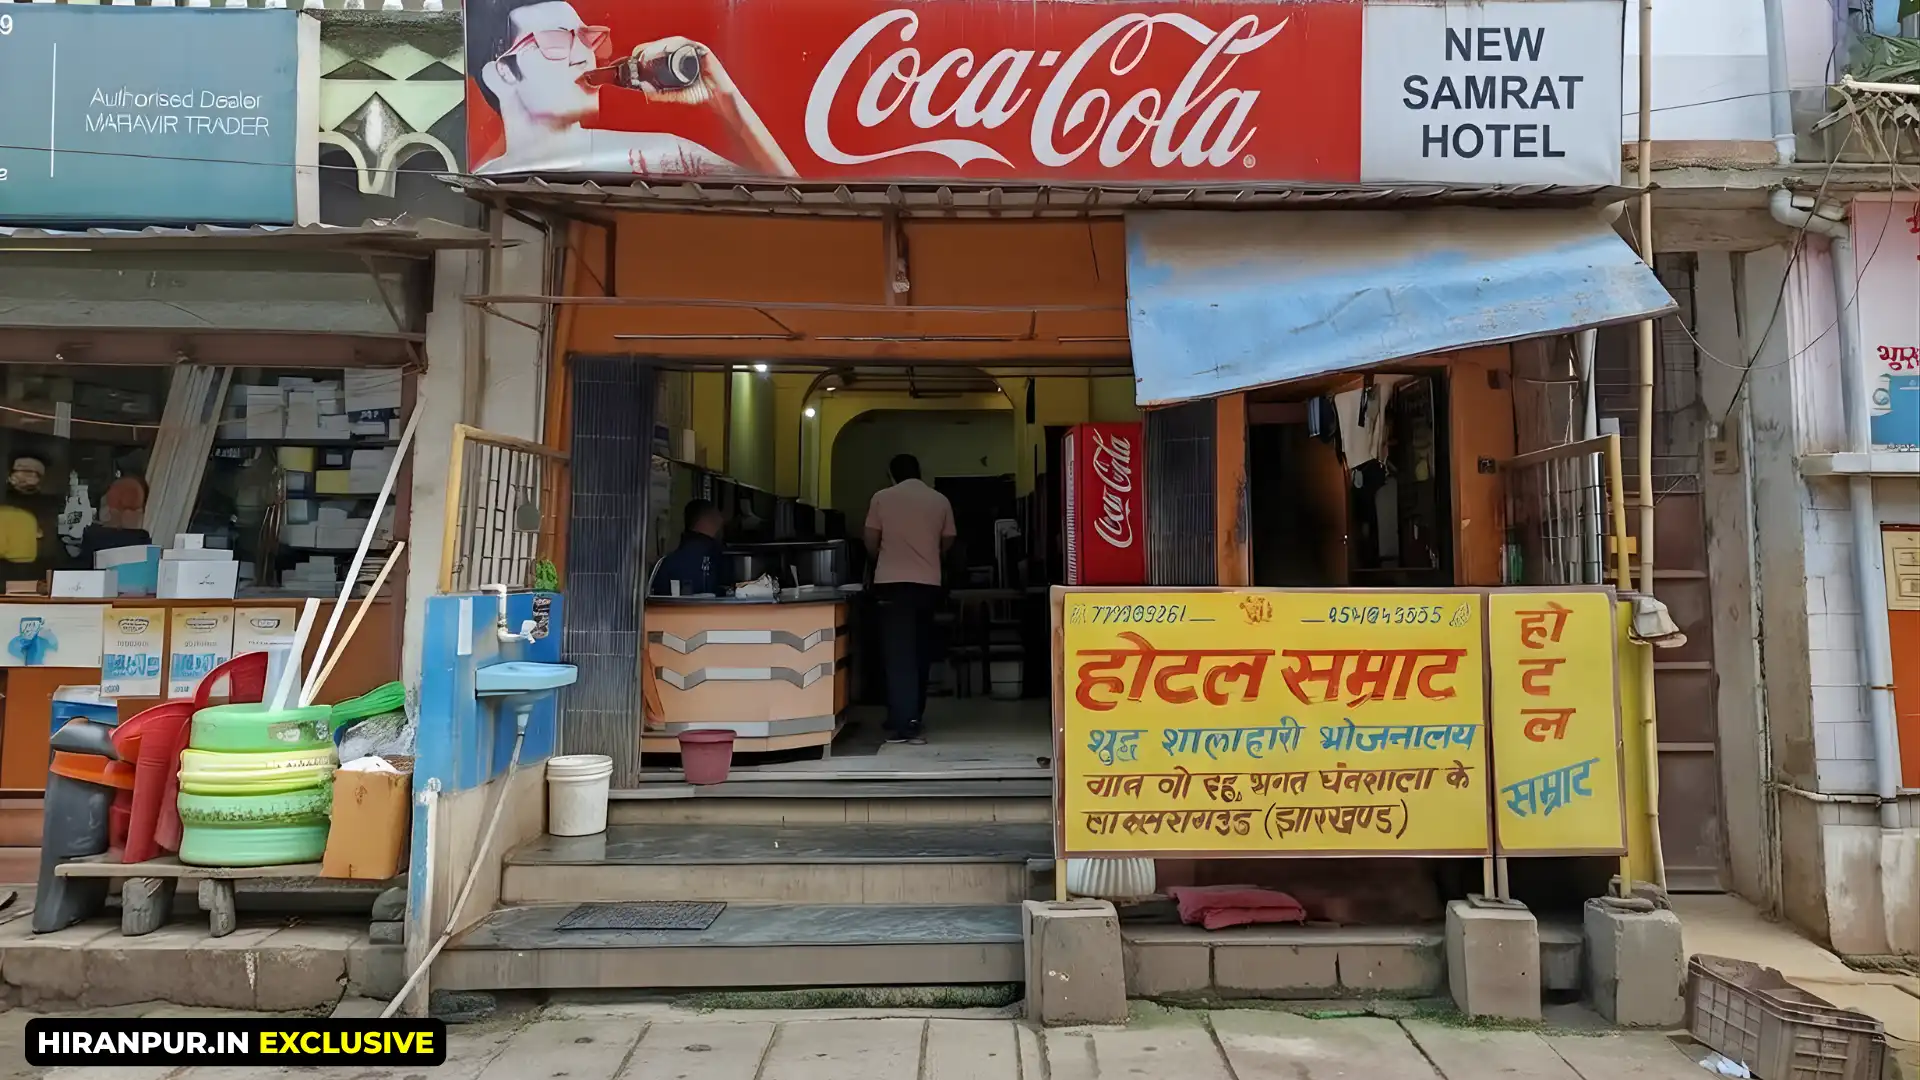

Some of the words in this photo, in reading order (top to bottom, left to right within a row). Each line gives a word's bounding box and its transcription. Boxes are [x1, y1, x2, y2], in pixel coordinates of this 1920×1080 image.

[1446, 28, 1544, 61] NEW
[805, 9, 1287, 168] Coca-Cola
[1403, 75, 1584, 110] SAMRAT
[184, 116, 270, 137] TRADER
[1423, 124, 1566, 159] HOTEL
[1075, 631, 1276, 711] होटल
[1281, 648, 1467, 709] सम्राट
[1319, 717, 1479, 751] भोजनालय
[1501, 757, 1600, 817] सम्राट
